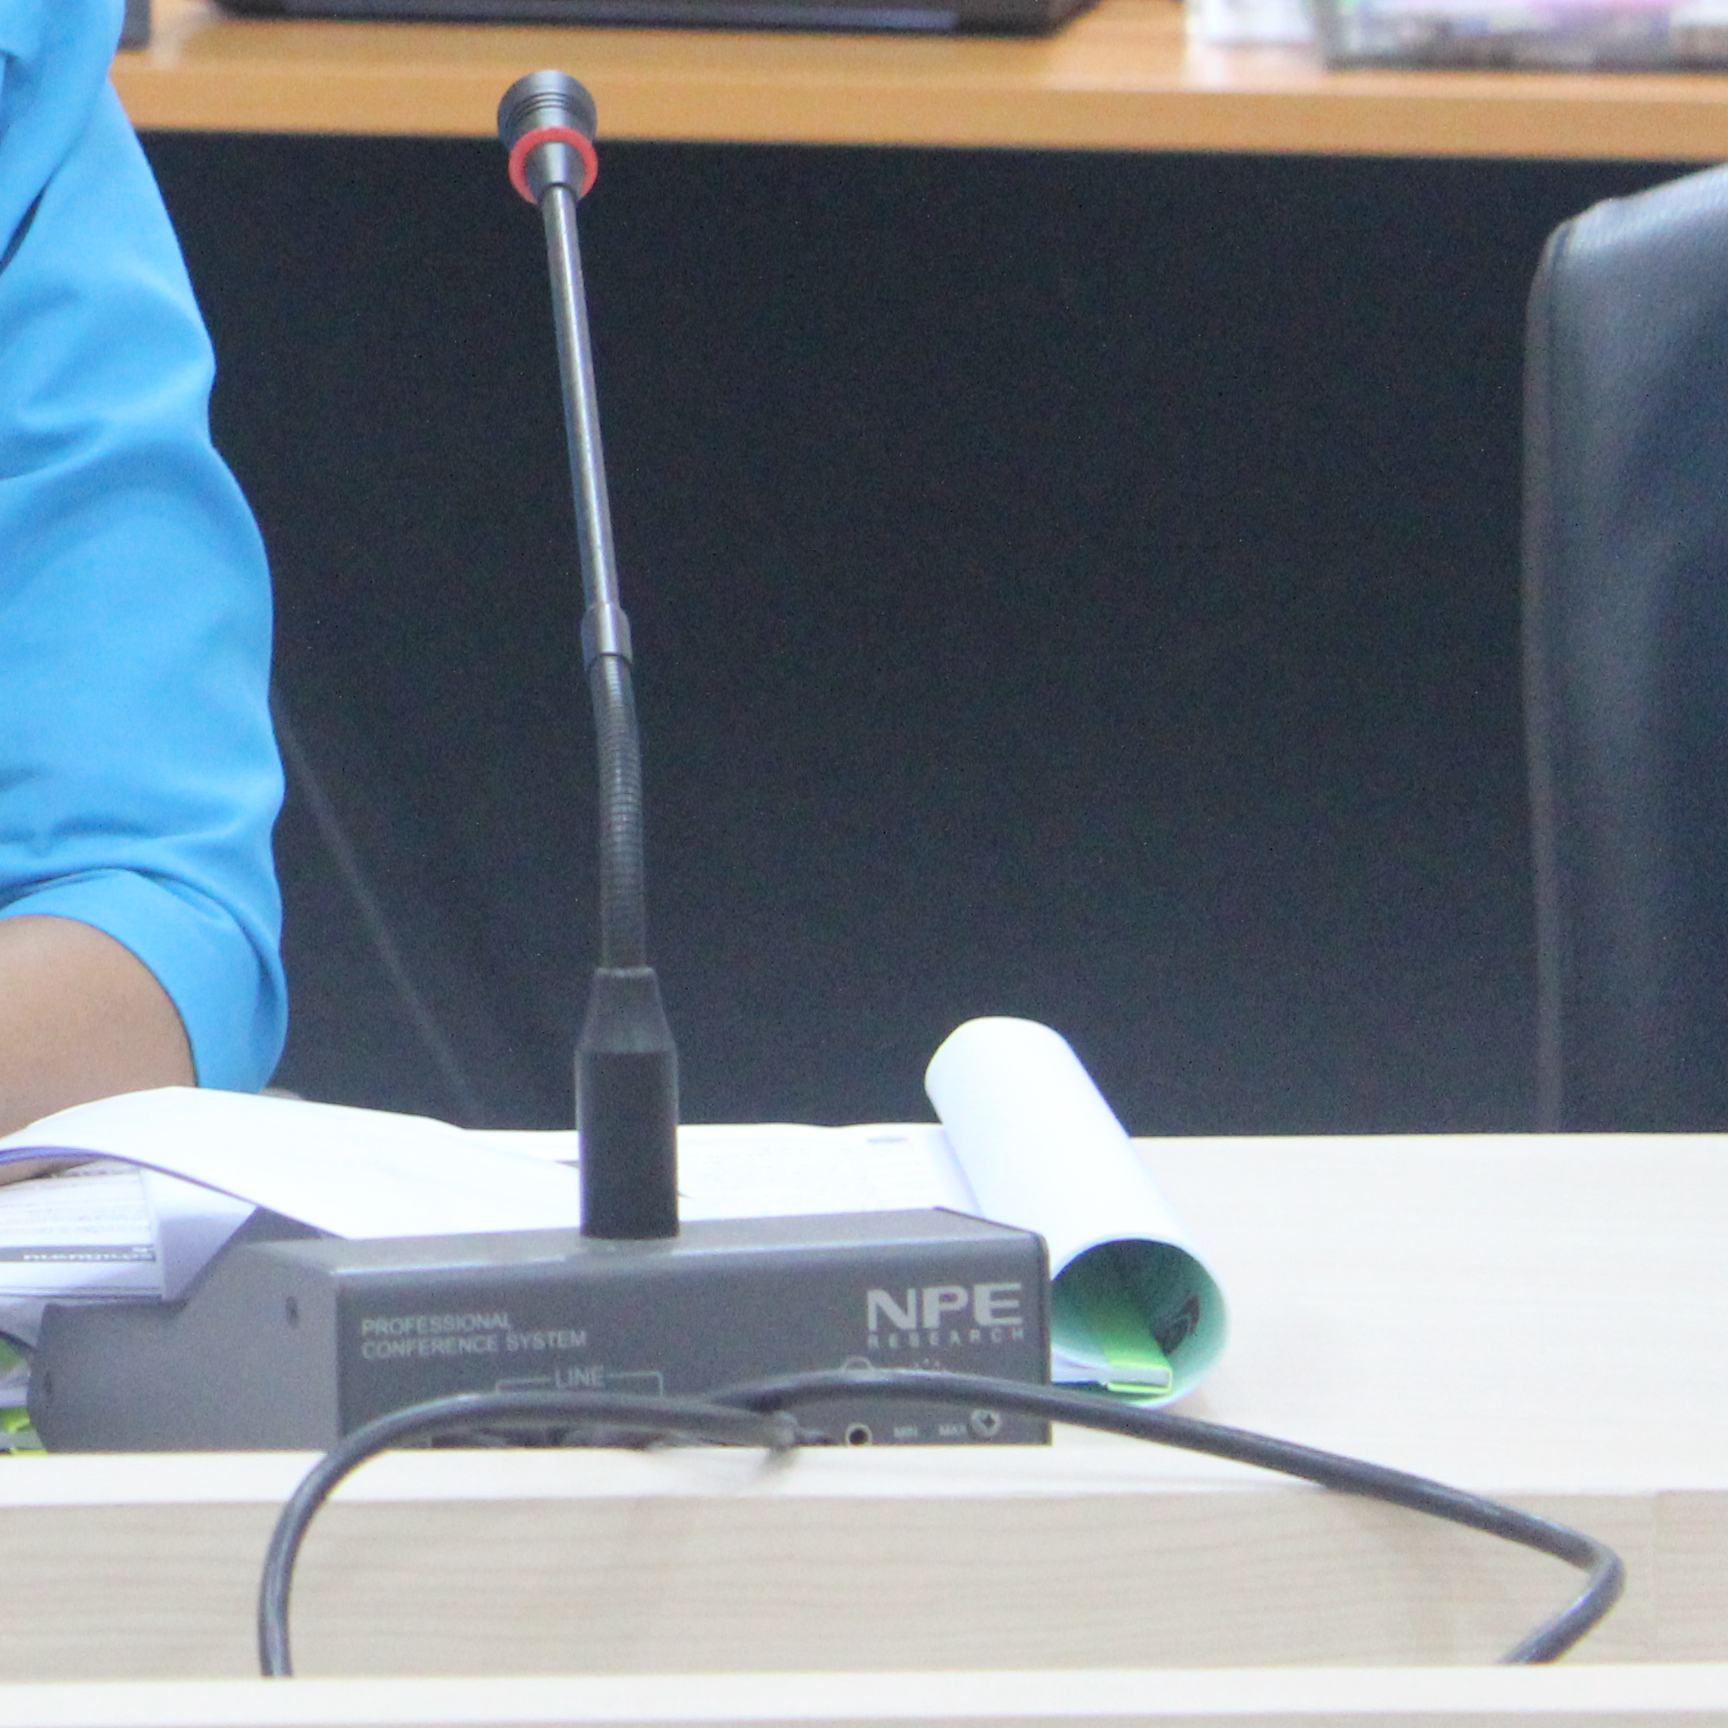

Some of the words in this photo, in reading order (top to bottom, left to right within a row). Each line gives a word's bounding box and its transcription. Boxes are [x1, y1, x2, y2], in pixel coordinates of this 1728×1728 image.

[866, 1281, 1024, 1333] NPE
[361, 1312, 513, 1339] PROFESSIONAL
[866, 1327, 1026, 1351] RESEARCH
[361, 1333, 499, 1361] CONFERENCE
[505, 1329, 589, 1353] SYSTEM
[554, 1366, 605, 1392] LINE
